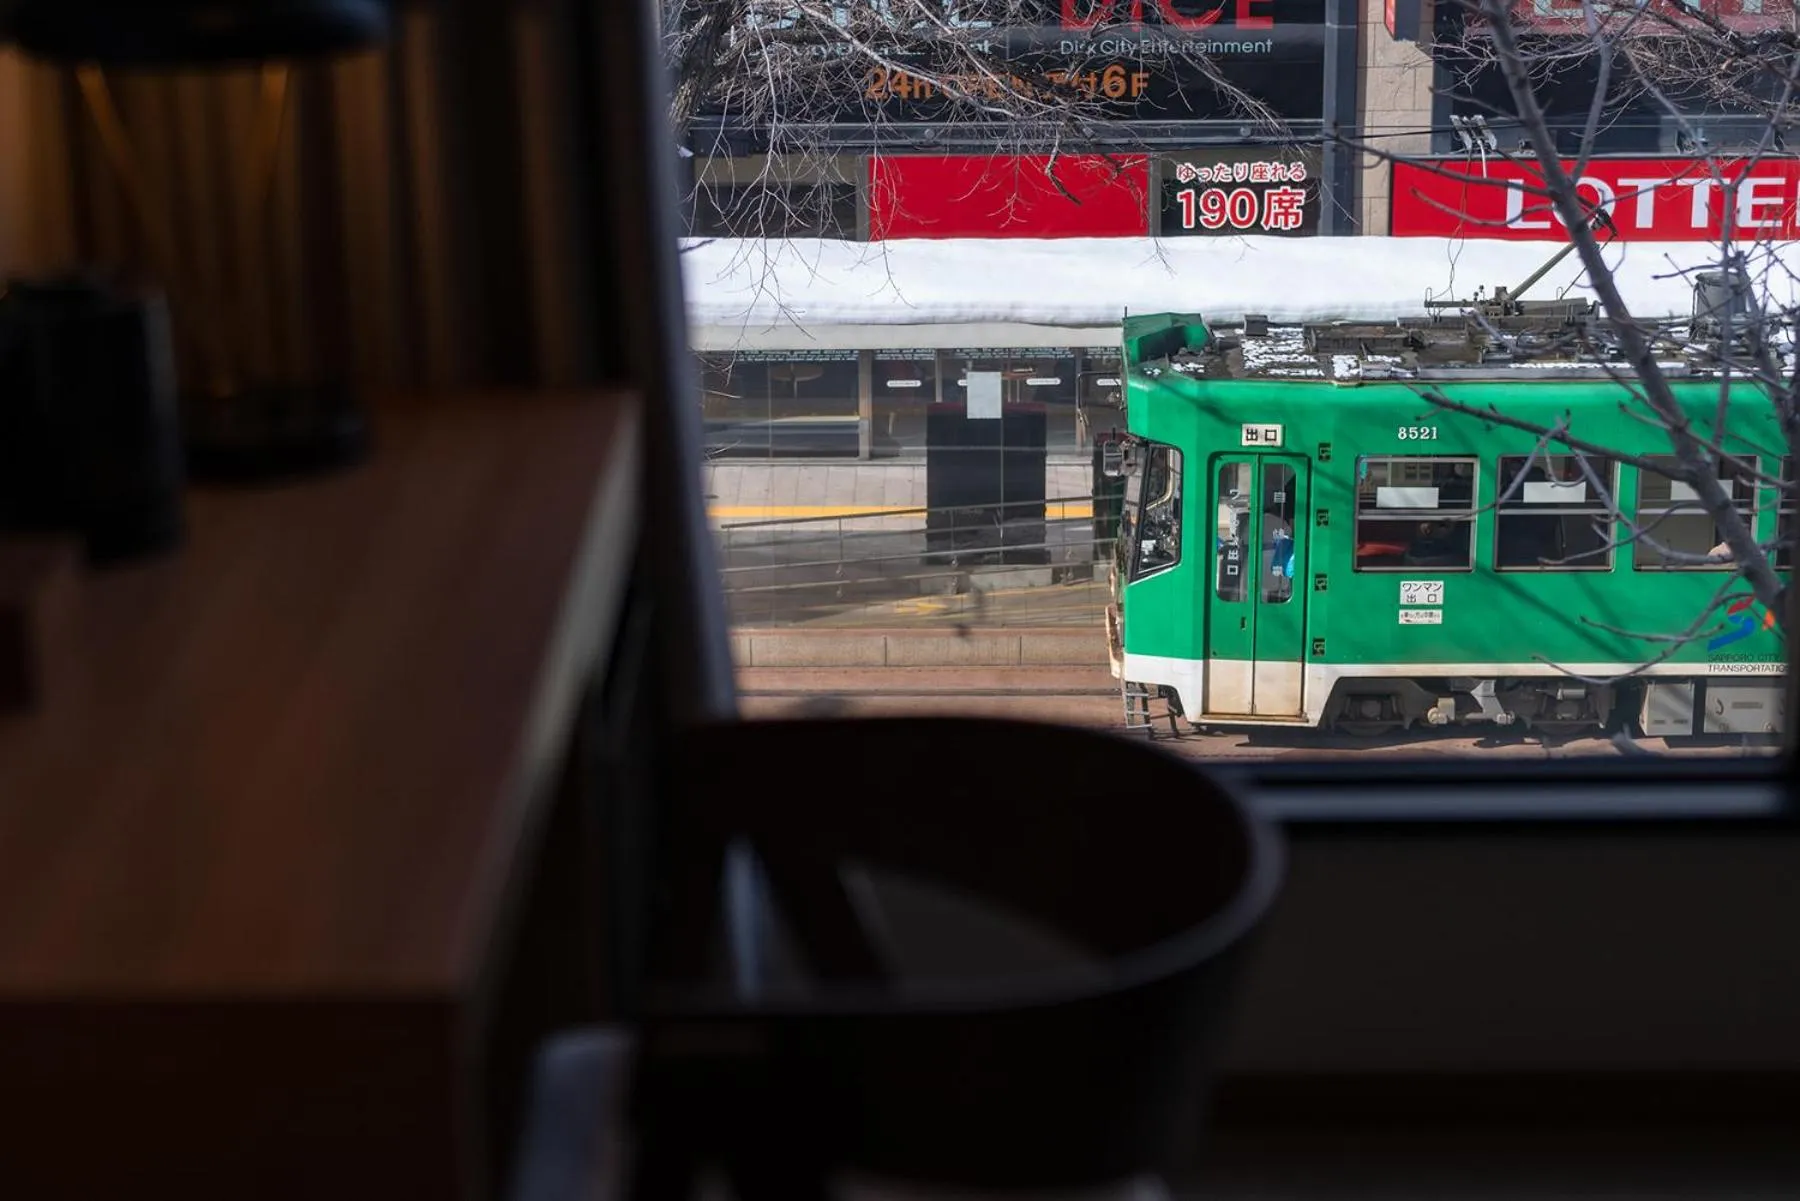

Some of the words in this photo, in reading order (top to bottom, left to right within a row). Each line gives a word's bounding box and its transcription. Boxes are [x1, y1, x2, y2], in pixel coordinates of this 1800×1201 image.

[1100, 39, 1136, 57] City
[1176, 162, 1306, 182] ゆったり座れる
[1177, 186, 1306, 230] 190席
[1506, 176, 1800, 229] LOTTE
[1245, 428, 1277, 442] 出口
[1398, 426, 1438, 440] 8521
[1402, 582, 1442, 592] ワンマン
[1406, 593, 1438, 603] 出口
[1708, 664, 1788, 673] TRANSPORTATIO
